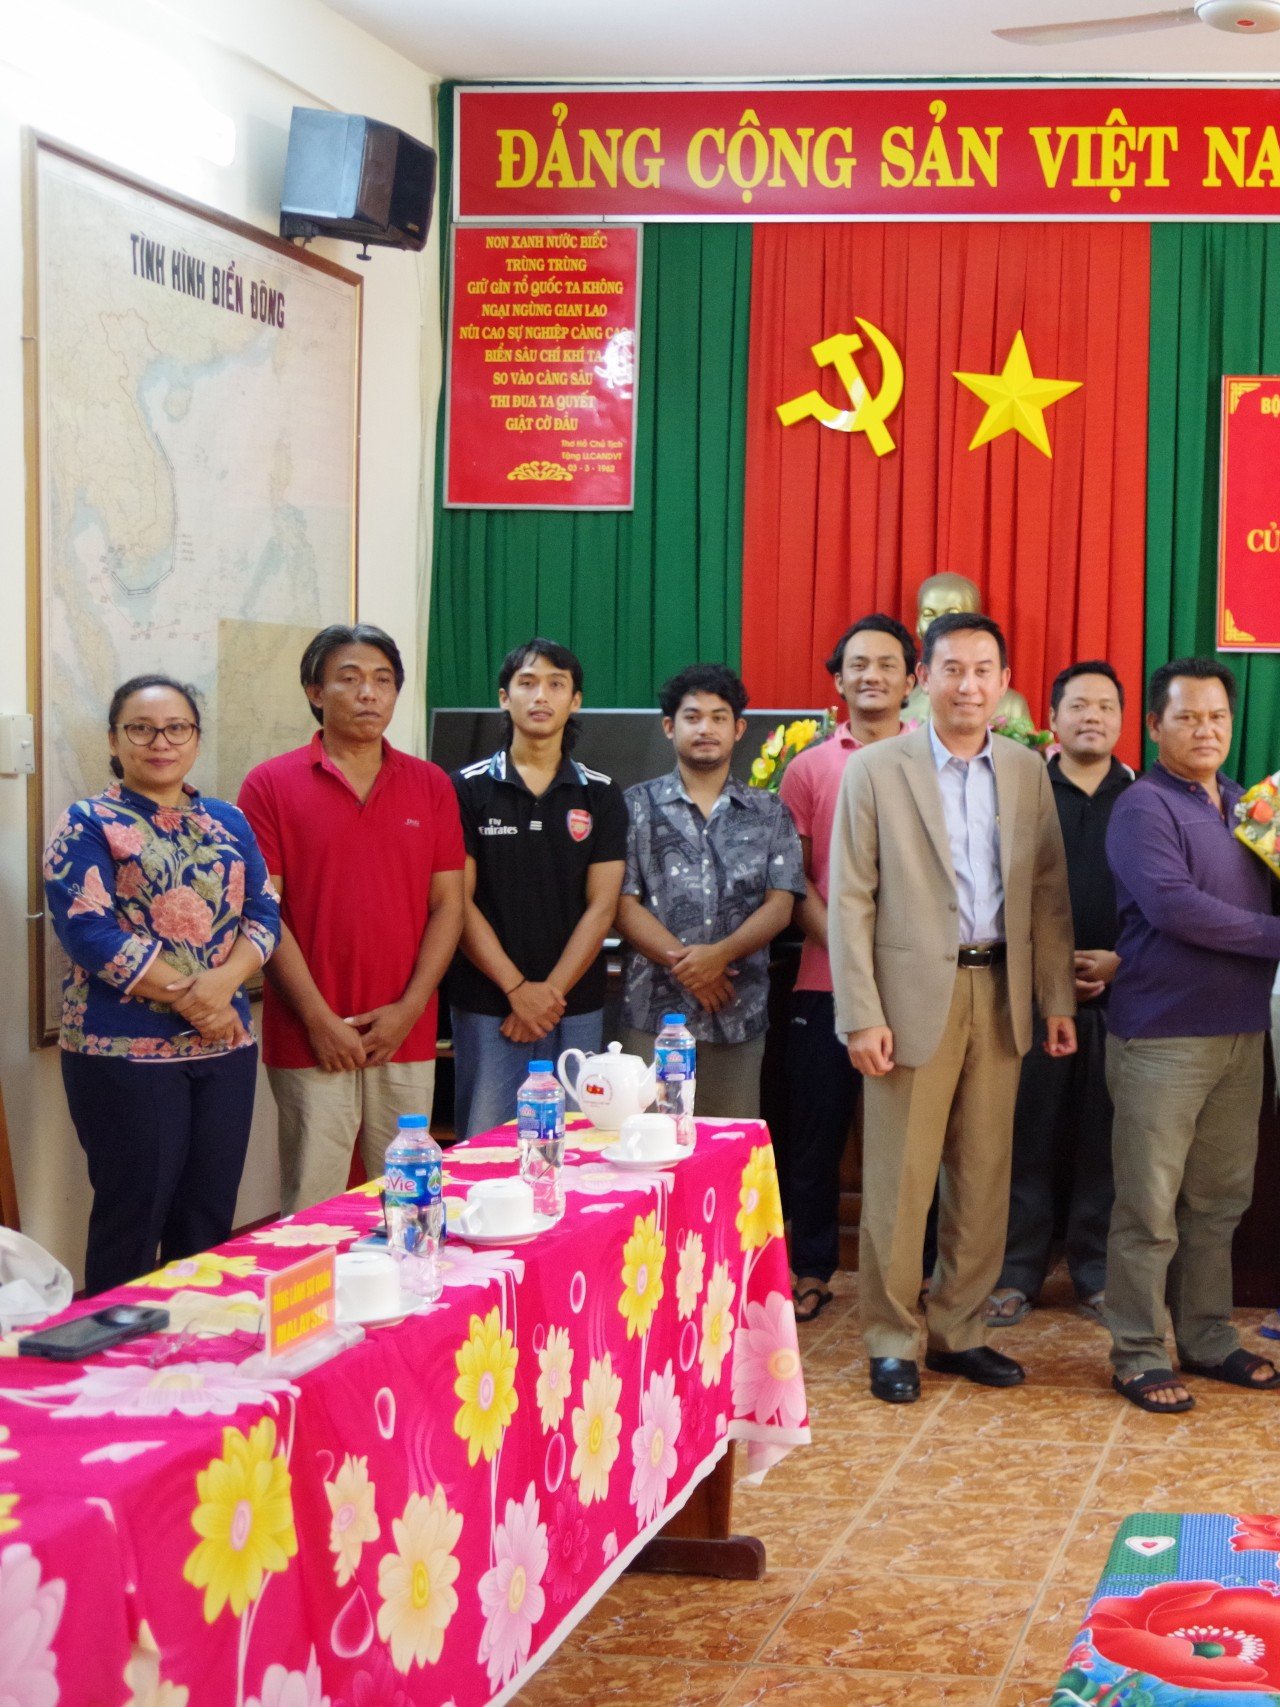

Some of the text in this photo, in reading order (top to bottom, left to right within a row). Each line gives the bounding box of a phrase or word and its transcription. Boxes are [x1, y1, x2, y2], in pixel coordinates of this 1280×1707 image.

[495, 101, 664, 190] ĐẢNG
[687, 109, 857, 204] CỘNG
[880, 100, 1001, 188] SẢN
[1029, 108, 1178, 202] VIỆT
[486, 229, 608, 248] NON XANH NƯỚC BIẾC
[505, 256, 587, 271] TRÙNG TRÙNG
[131, 231, 165, 285] TÌNH
[172, 247, 205, 300] HÌNH
[212, 260, 243, 314] BIỂN
[251, 279, 285, 329] ĐÔNG
[467, 275, 624, 297] GIỮ GÌN TỔ QUỐC TA KHÔNG
[482, 301, 607, 319] NGẠI NGÙNG GIAN LAO
[460, 324, 480, 339] NÚI
[482, 327, 505, 339] CAO
[507, 325, 523, 342] SỰ
[525, 324, 569, 342] NGHIỆP
[571, 324, 603, 340] CÀNG
[485, 343, 604, 363] BIỂN SÂU CHÍ KHÍ TA
[493, 369, 593, 385] SO VÀO CÀNG SÂU
[490, 390, 597, 411] THI ĐUA TA QUYẾT
[1261, 394, 1280, 417] BỘ
[506, 410, 579, 433] GIẬT CỜ ĐẦU
[478, 826, 518, 835] Emirates
[489, 818, 501, 826] Fly
